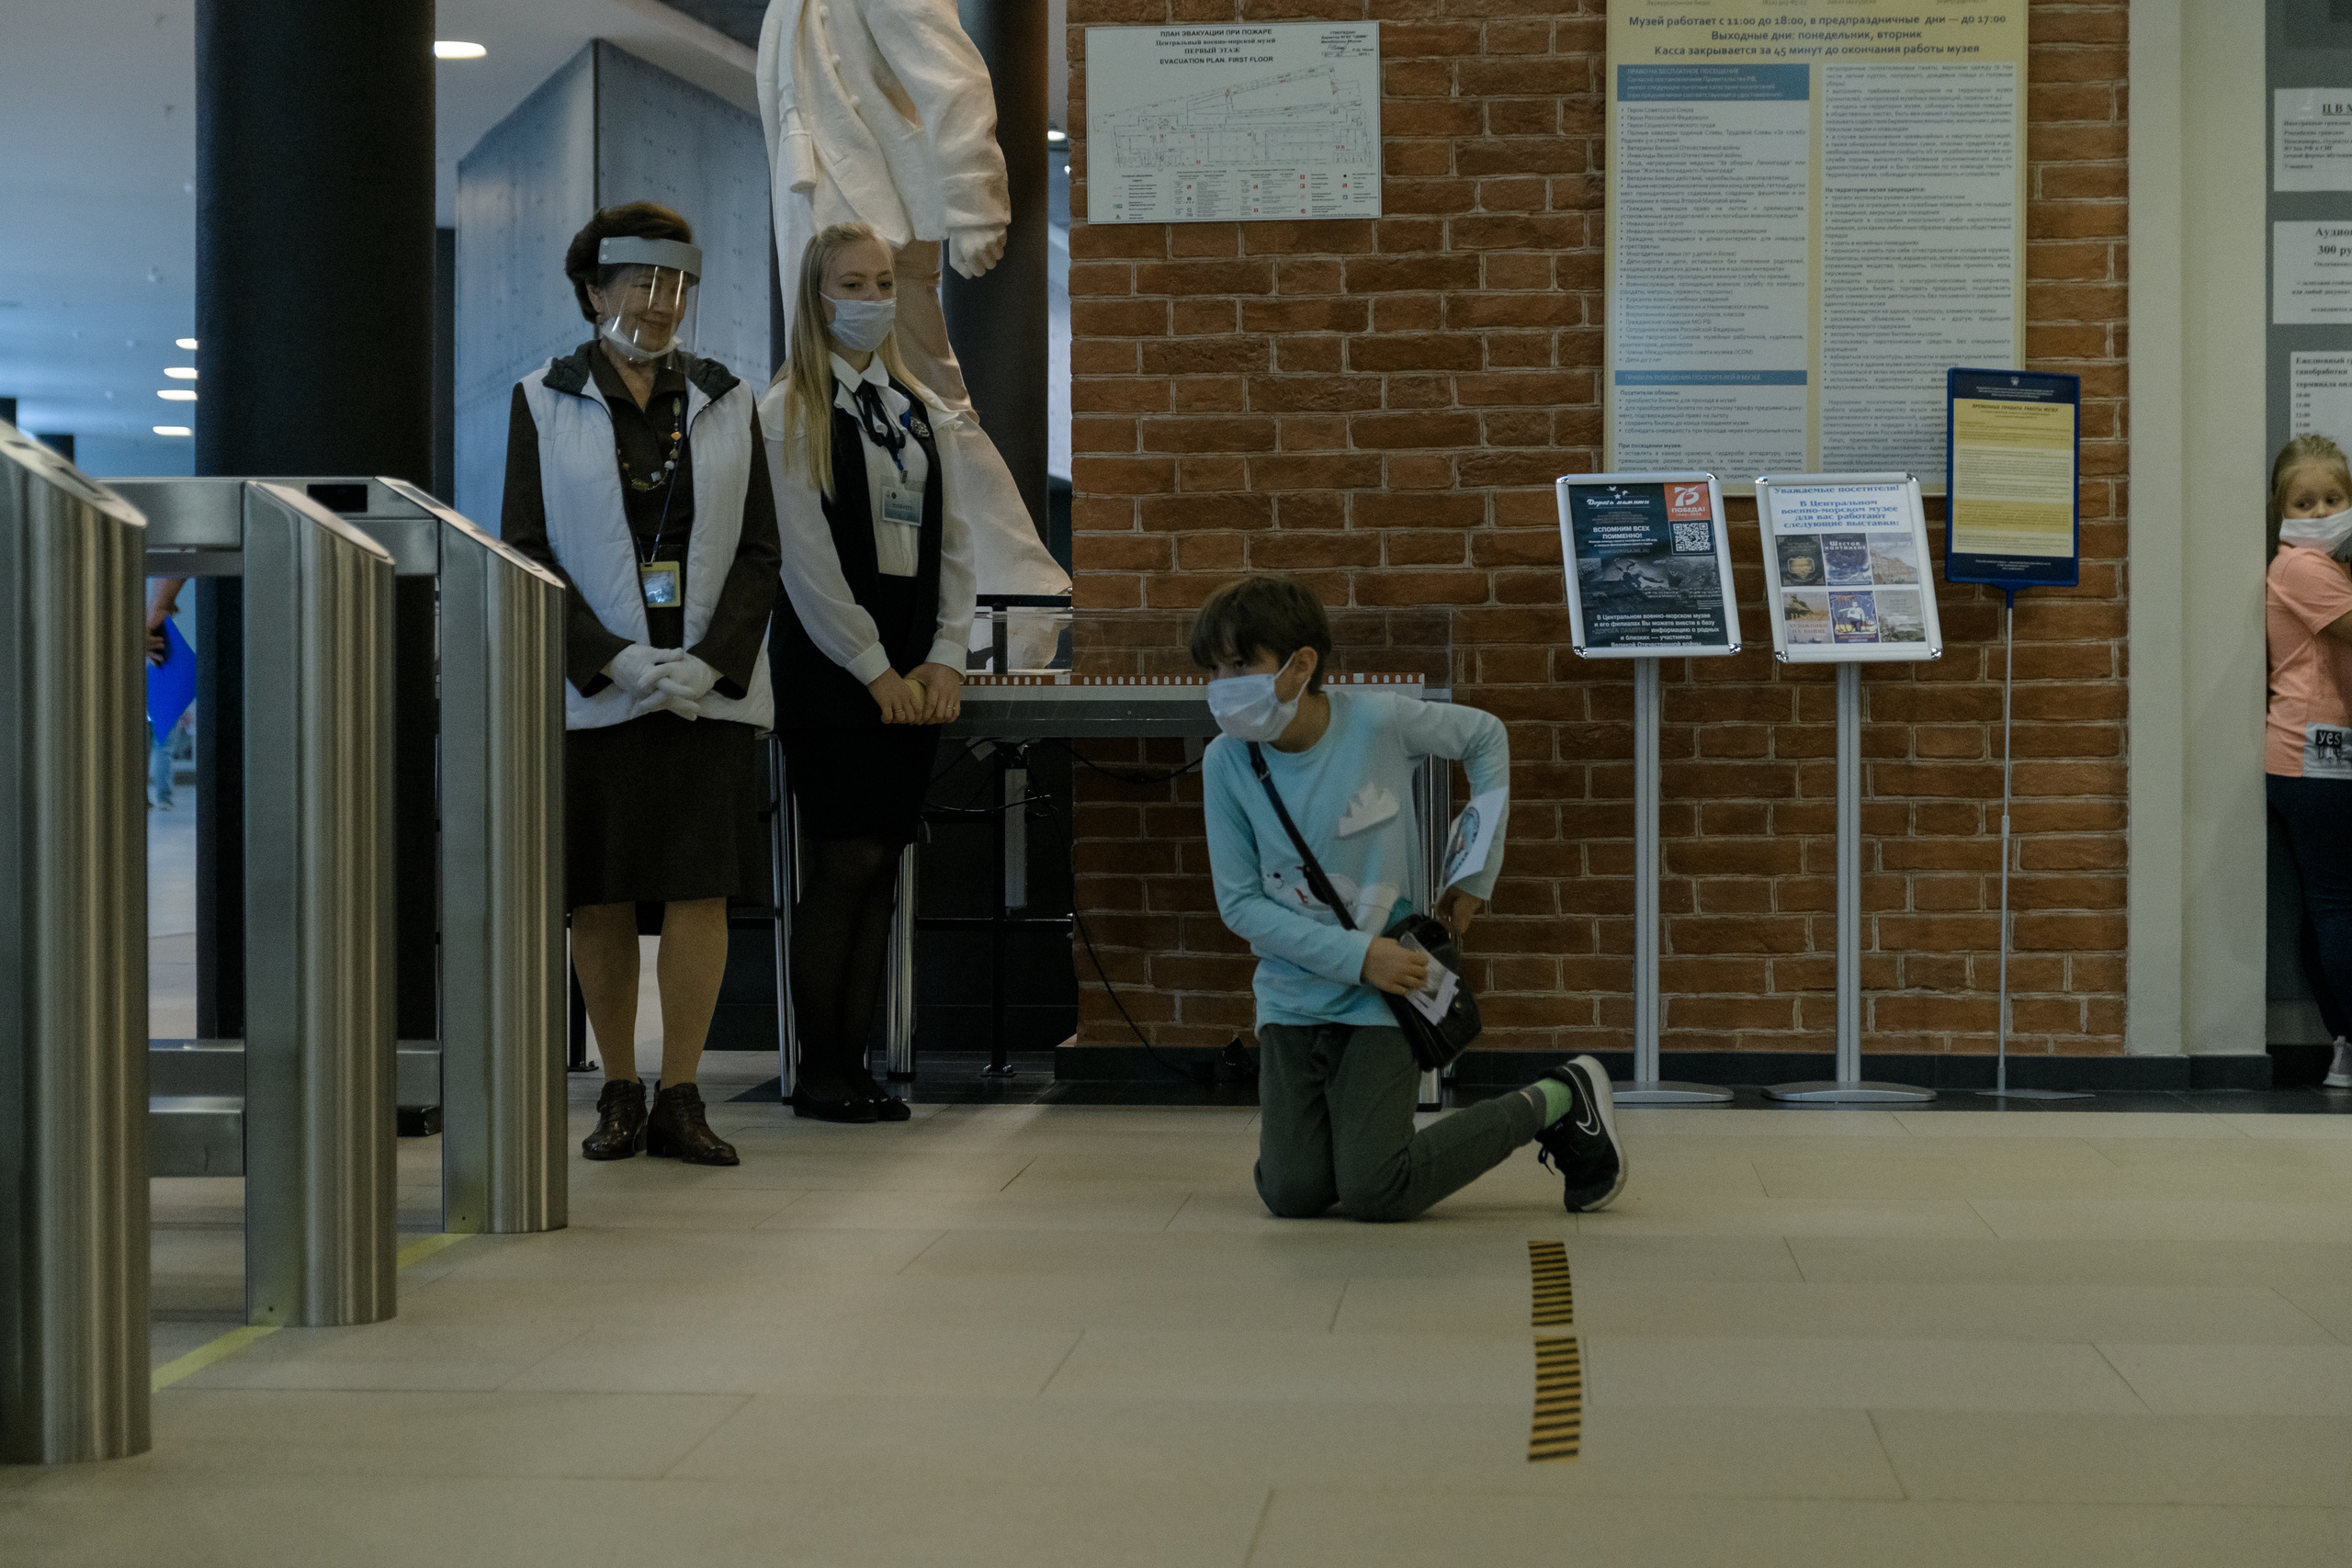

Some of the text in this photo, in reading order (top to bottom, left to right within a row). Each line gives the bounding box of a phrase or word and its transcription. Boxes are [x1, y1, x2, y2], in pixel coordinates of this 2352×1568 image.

[1629, 15, 2007, 28] Музей работает с 11:00 до 18:00, в предпраздничные дни до 17:00
[1711, 30, 1923, 41] Выходные дни: понедельник, вторник
[1155, 39, 1201, 47] Центральный
[1655, 47, 1685, 55] Касса
[1688, 47, 1757, 57] закрывается
[1759, 47, 1770, 55] за
[1774, 47, 1786, 56] 45
[1789, 46, 1821, 56] минут
[1825, 46, 1838, 55] до
[1903, 43, 1944, 56] работы
[1946, 45, 1980, 55] музея
[1774, 483, 1899, 494] Уважаемые посетители!
[1674, 485, 1700, 507] 75
